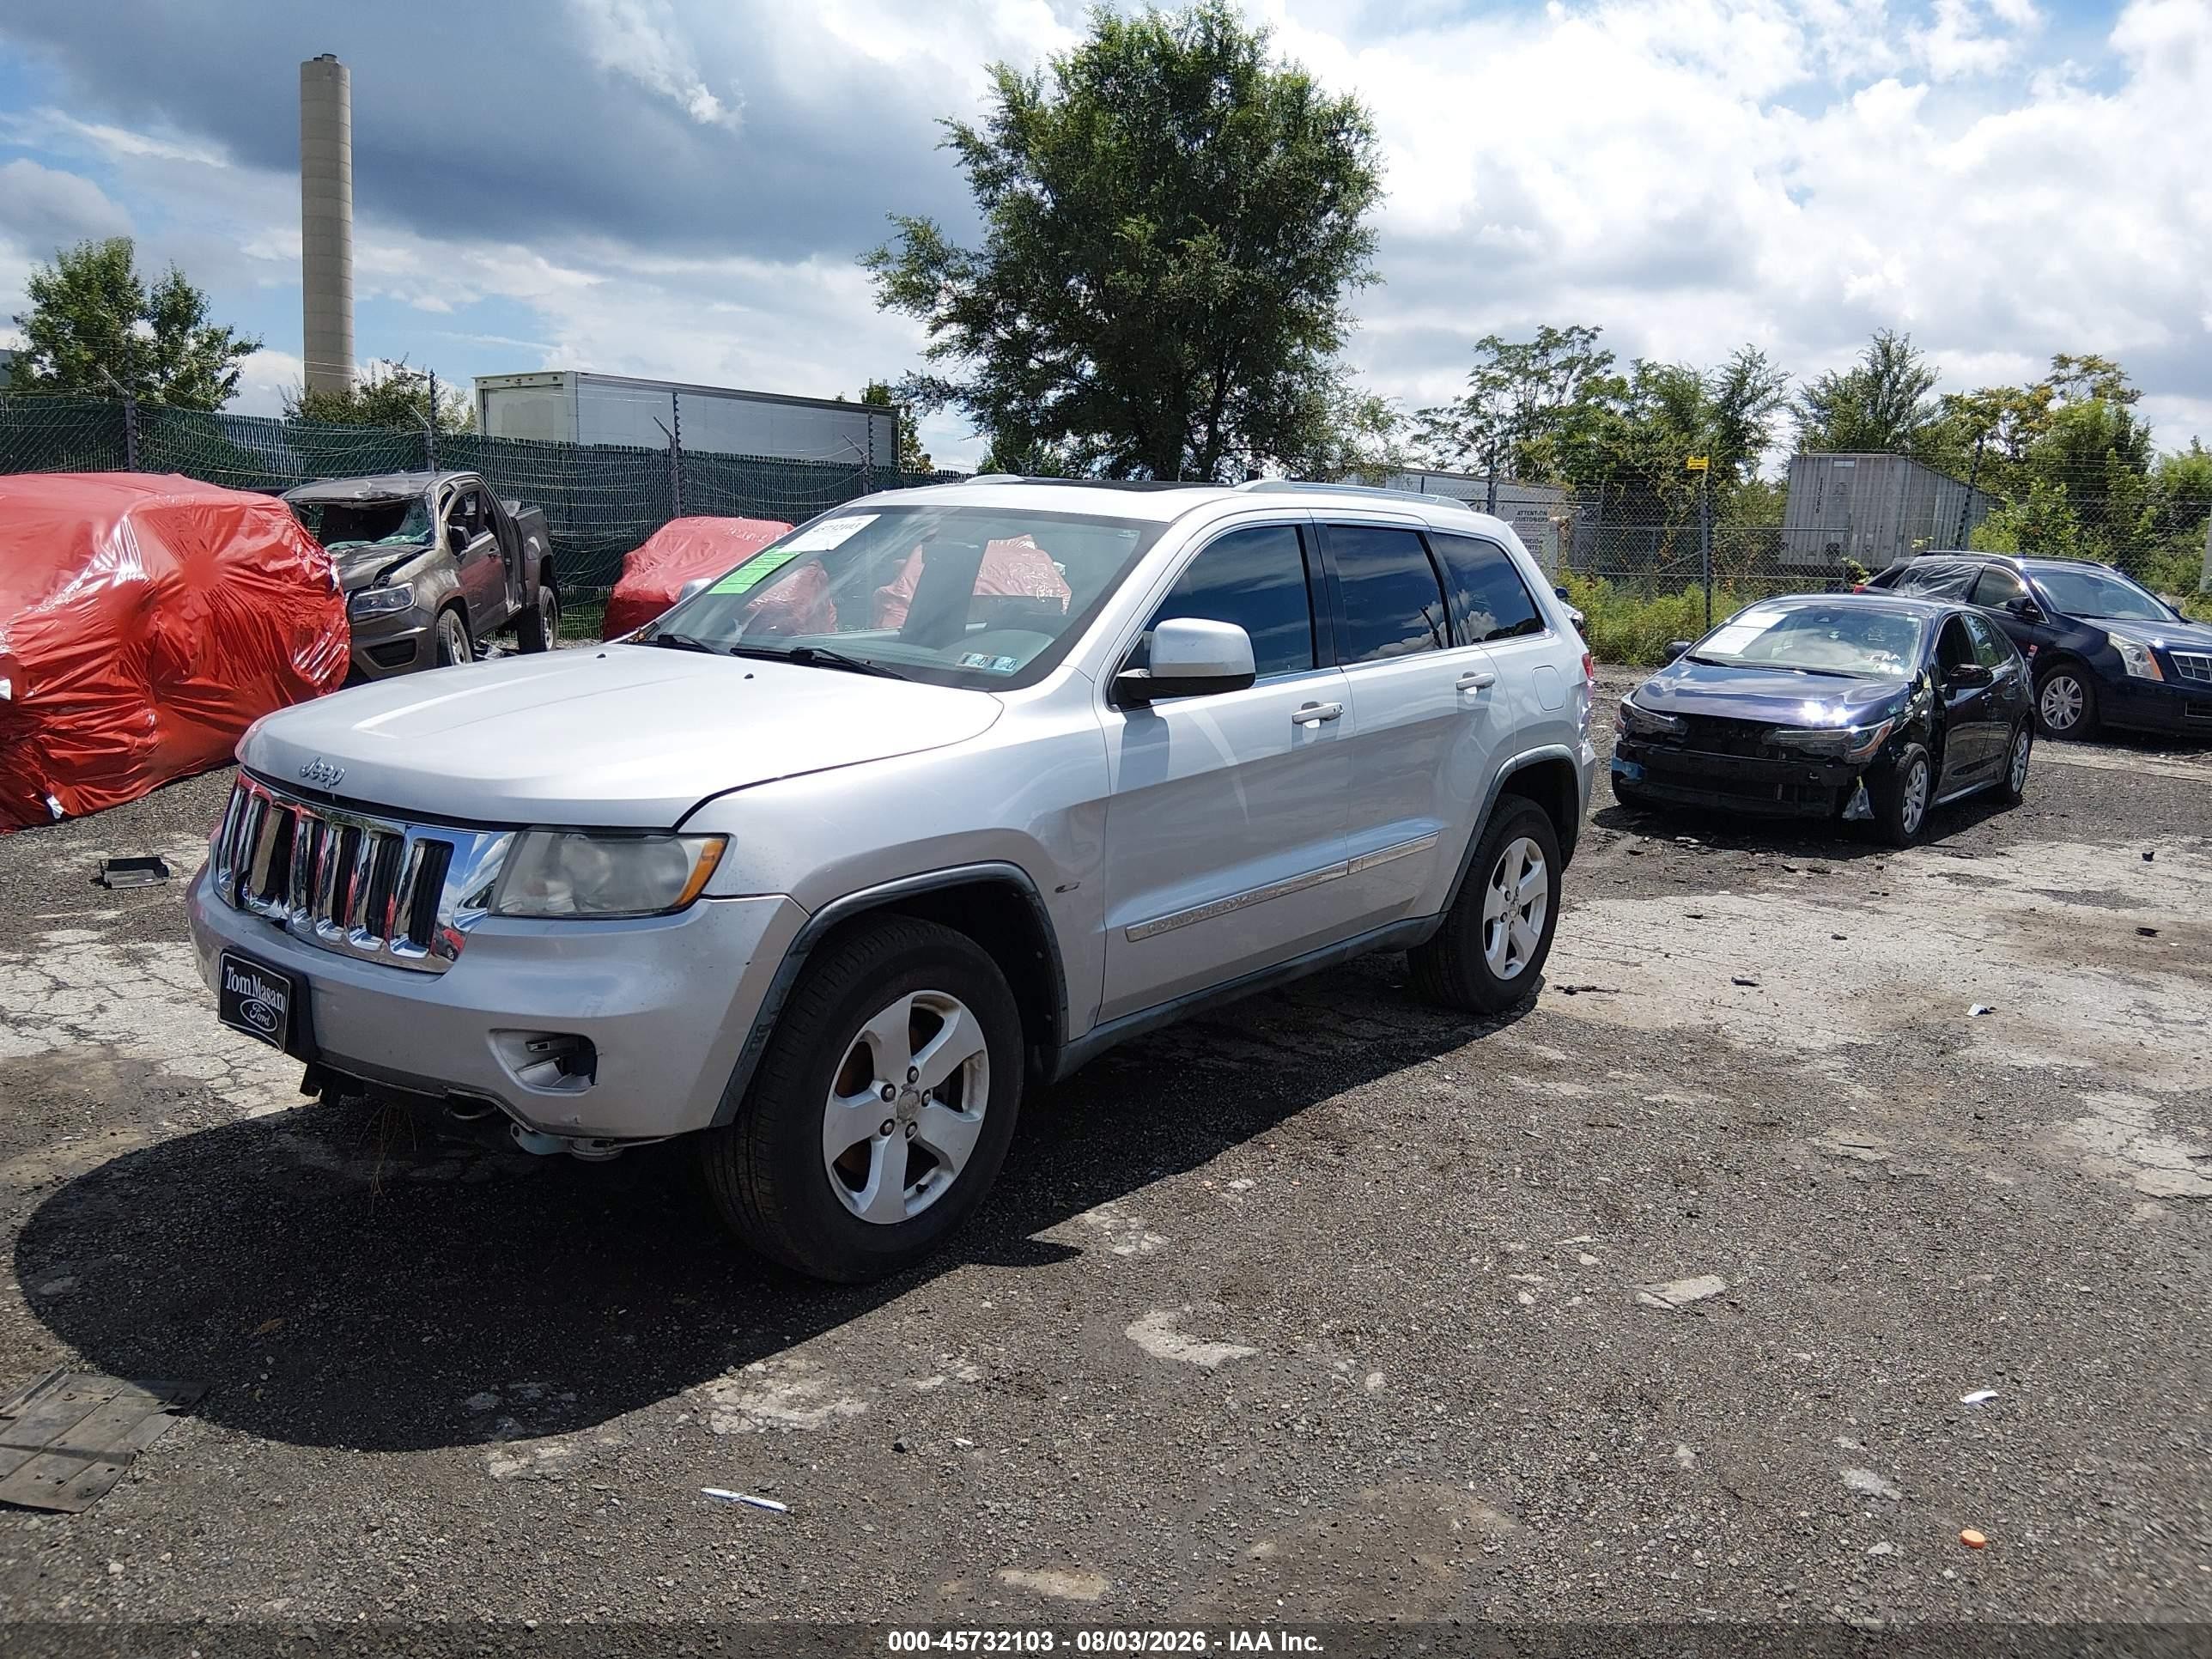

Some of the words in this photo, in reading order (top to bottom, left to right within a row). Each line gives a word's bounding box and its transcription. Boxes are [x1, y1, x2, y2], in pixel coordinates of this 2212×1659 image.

[299, 756, 346, 789] Jeep
[226, 965, 252, 996] Tom
[249, 1002, 271, 1027] Ford
